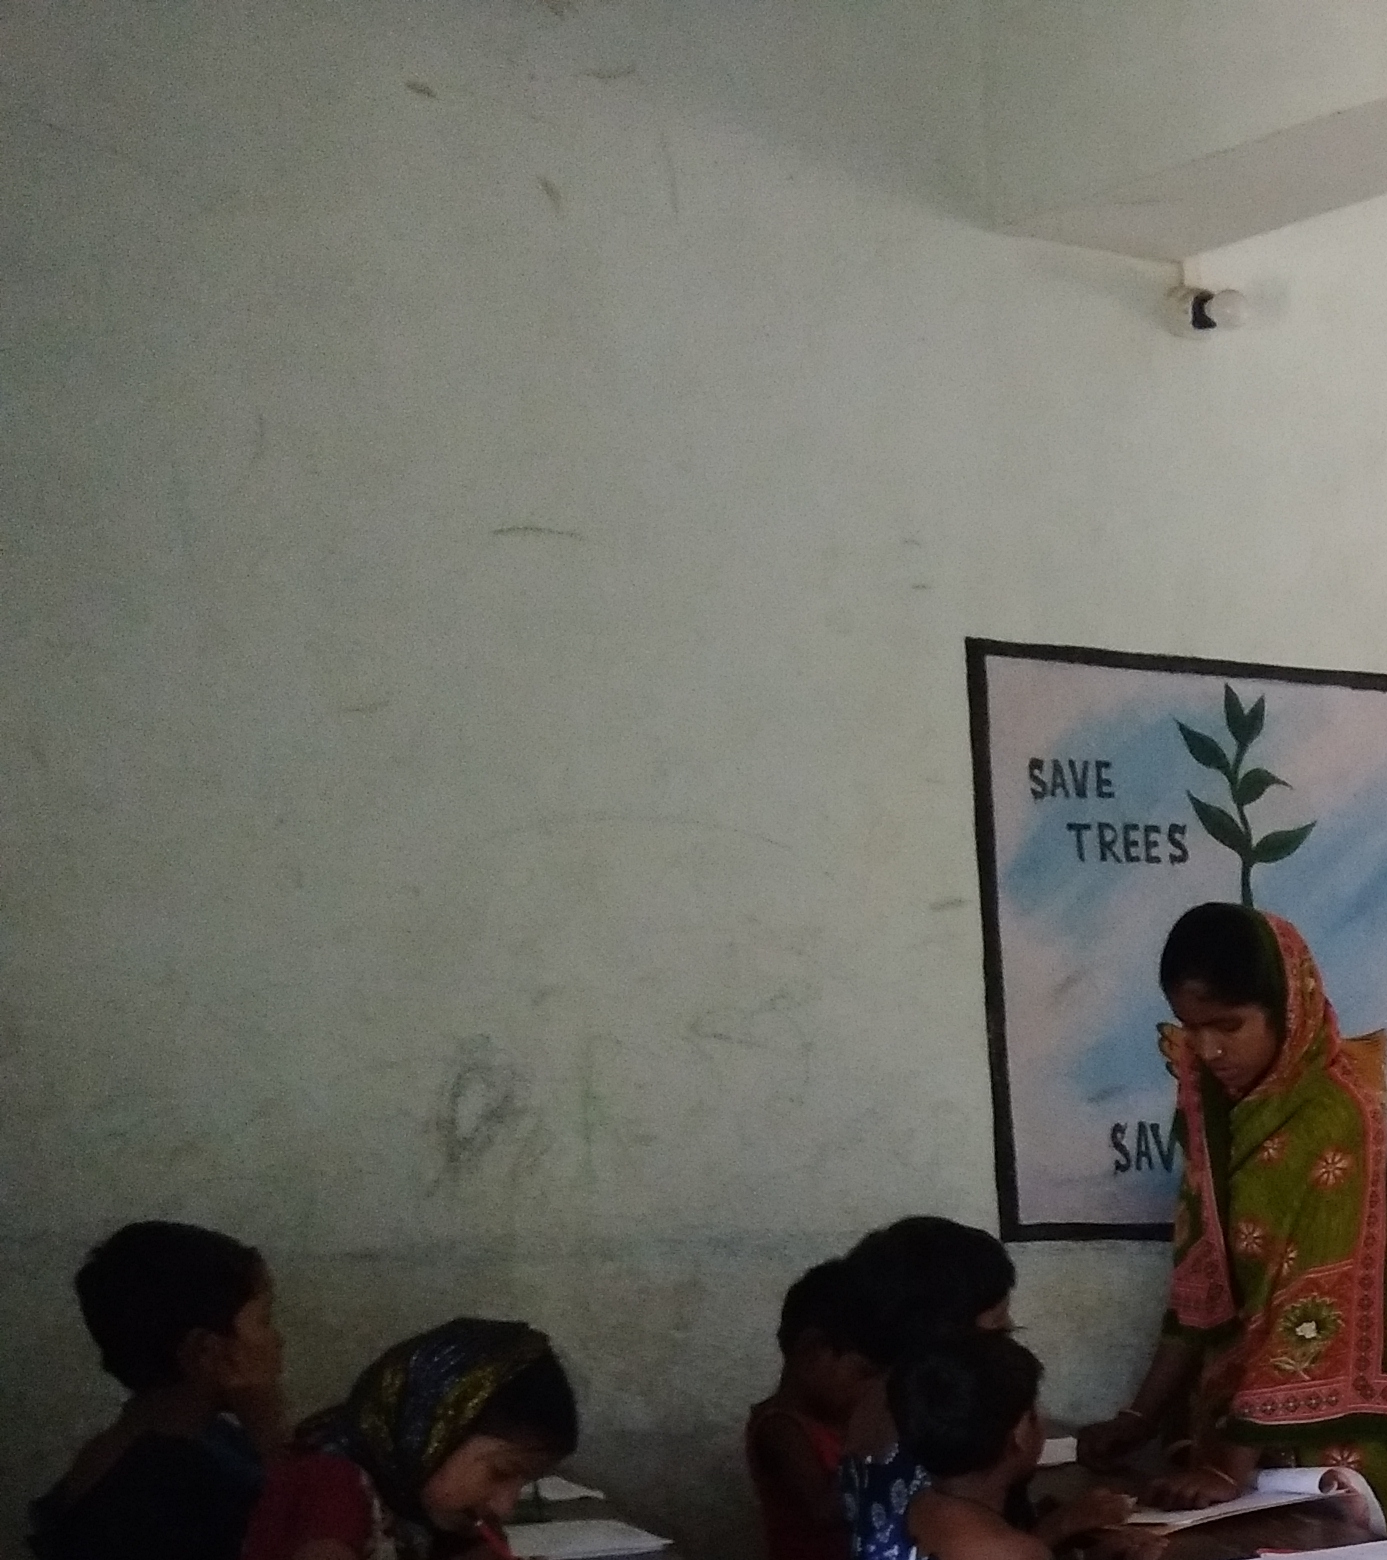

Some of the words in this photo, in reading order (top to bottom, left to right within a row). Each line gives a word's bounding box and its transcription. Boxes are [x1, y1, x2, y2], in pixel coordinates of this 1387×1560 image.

[1028, 756, 1115, 800] SAVE
[1066, 822, 1189, 865] TREES
[1110, 1121, 1177, 1174] SAV
